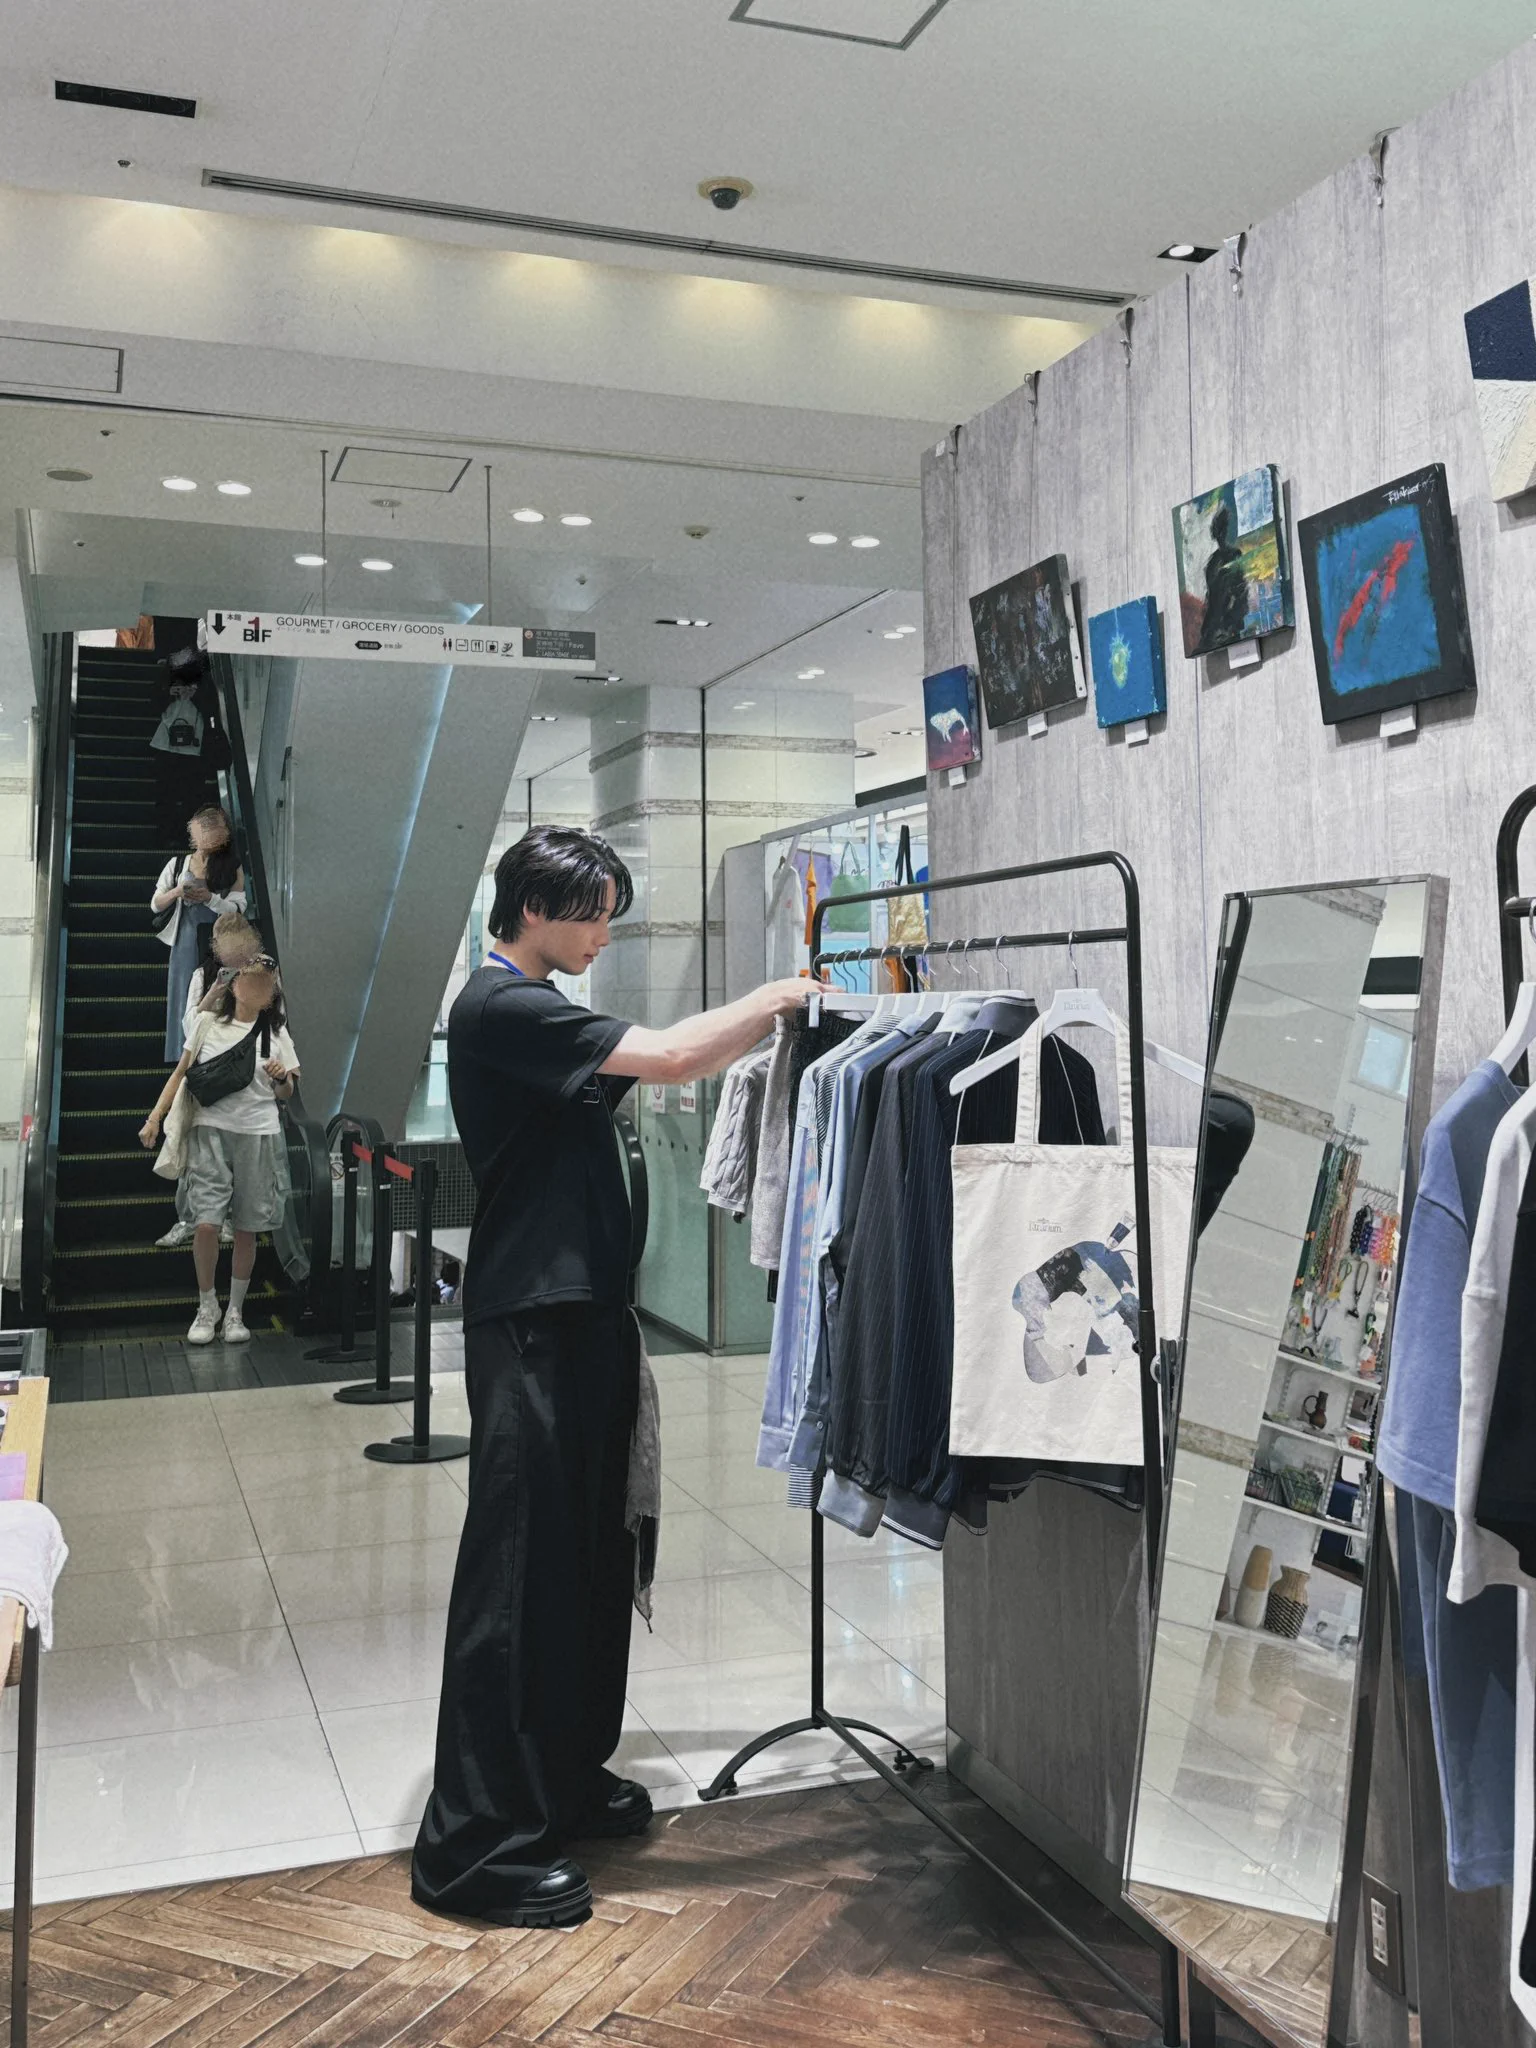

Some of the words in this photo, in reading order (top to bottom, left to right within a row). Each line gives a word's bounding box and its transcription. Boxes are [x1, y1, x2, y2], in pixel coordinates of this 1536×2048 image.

[276, 616, 335, 629] GOURMET
[342, 621, 398, 633] GROCERY
[404, 624, 445, 635] GOODS
